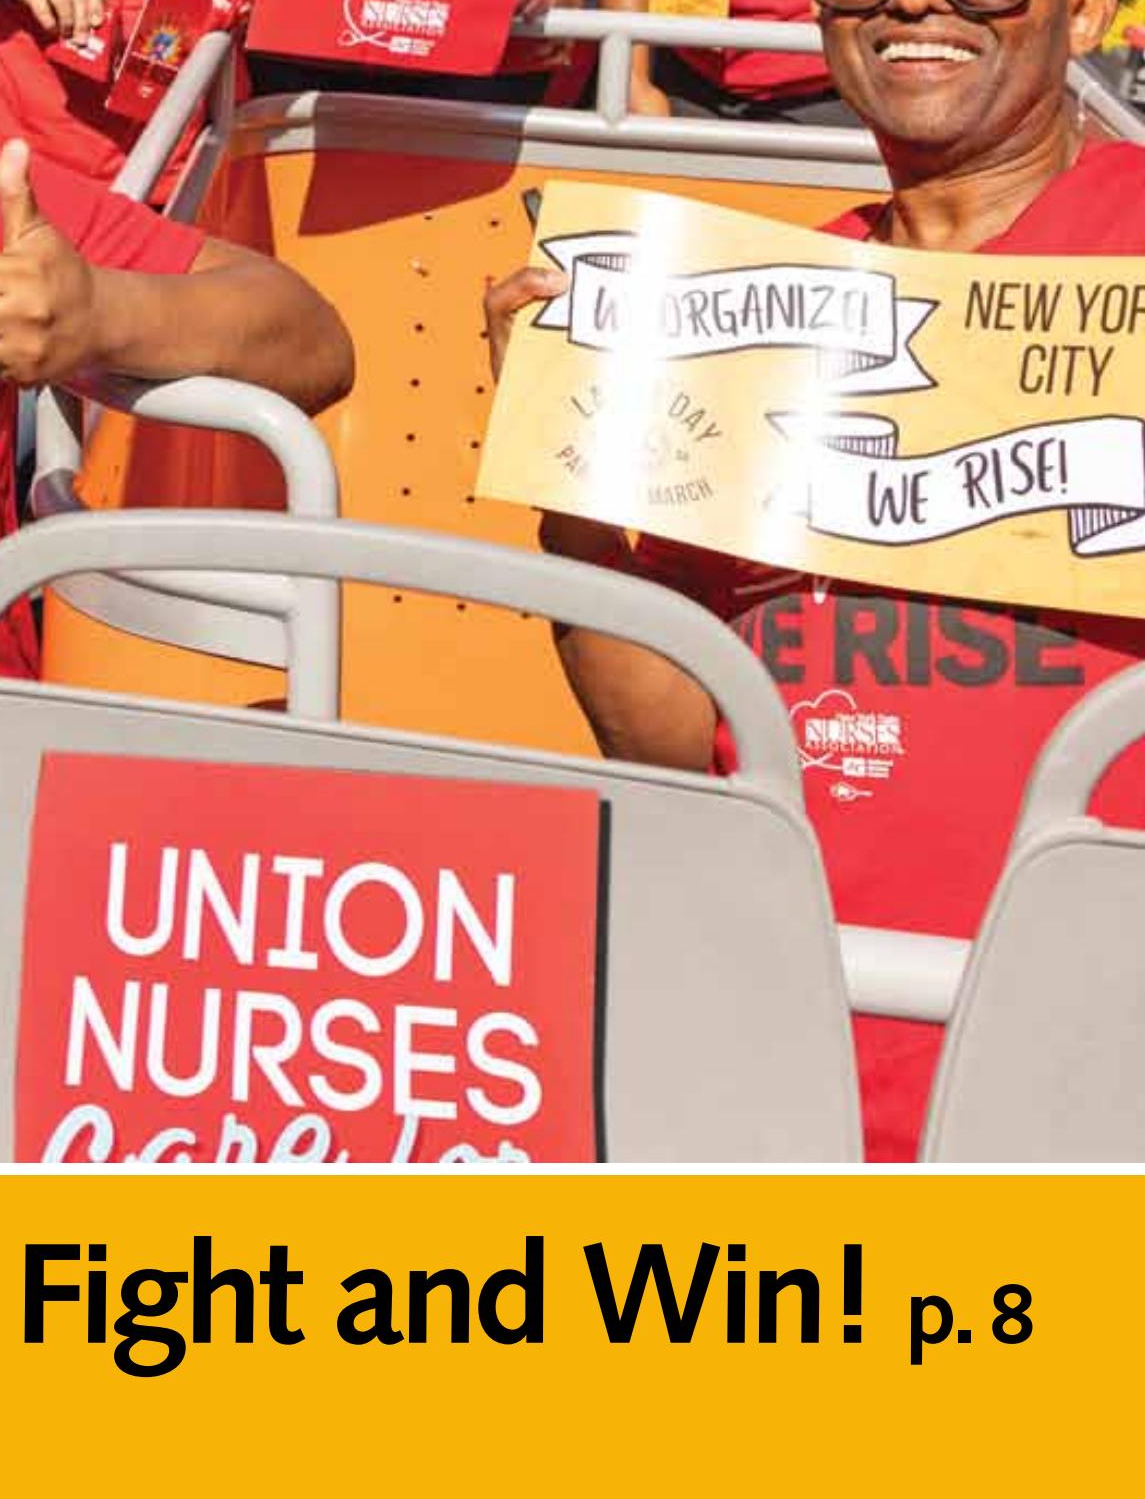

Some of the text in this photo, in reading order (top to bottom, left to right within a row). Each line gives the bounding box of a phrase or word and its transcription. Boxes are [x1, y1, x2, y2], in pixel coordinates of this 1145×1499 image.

[964, 281, 1145, 334] NEW YO
[1018, 344, 1115, 396] CITY
[668, 391, 724, 443] DAY
[866, 437, 1071, 526] WE RISE!
[833, 594, 1086, 687] RISE
[105, 842, 516, 987] UNION
[64, 975, 543, 1126] NURSES
